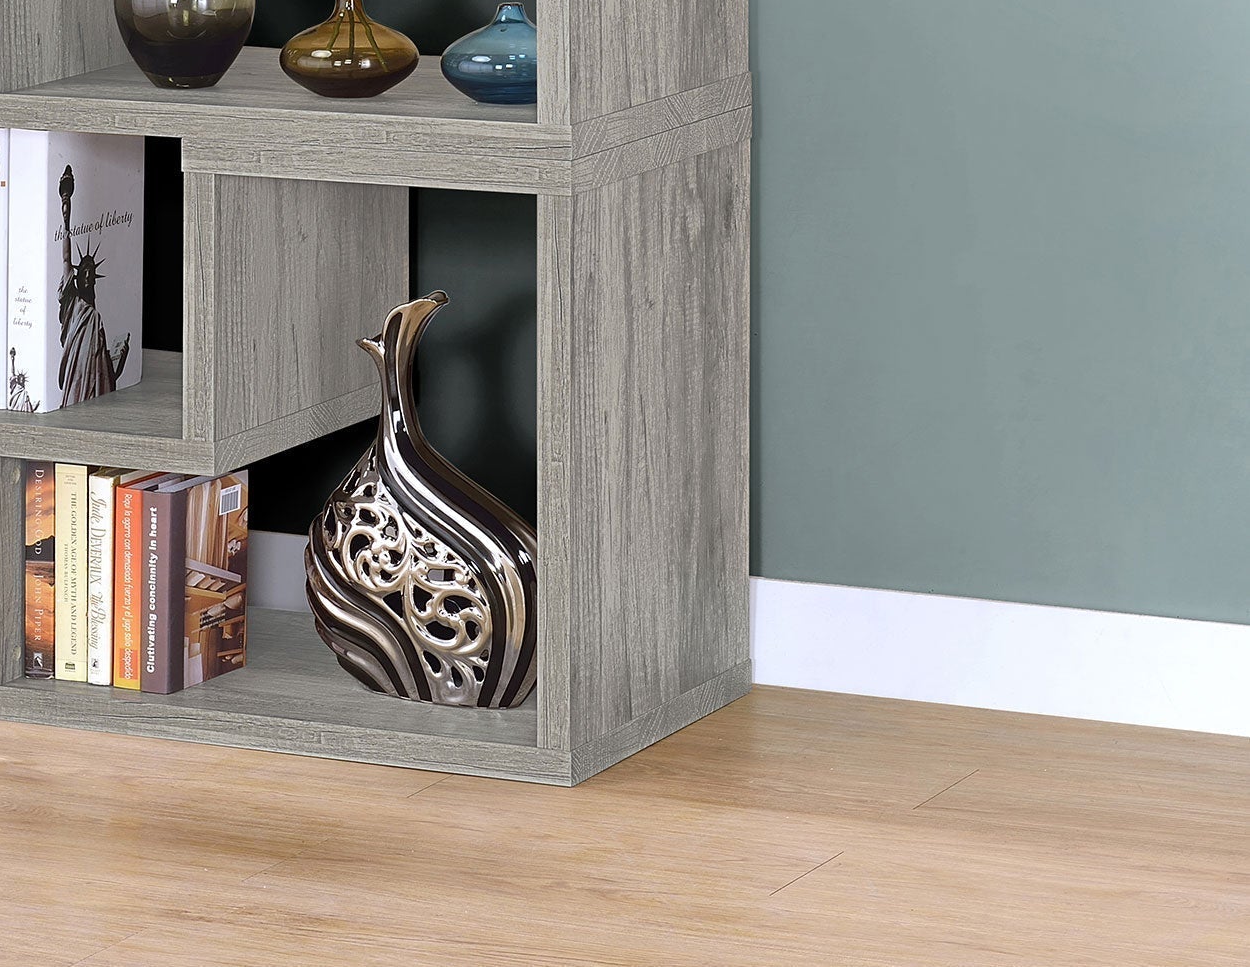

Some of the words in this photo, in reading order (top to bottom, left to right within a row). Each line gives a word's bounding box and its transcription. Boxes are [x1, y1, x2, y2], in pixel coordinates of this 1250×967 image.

[54, 225, 68, 242] the
[67, 222, 95, 239] statue
[94, 213, 105, 236] of
[105, 210, 134, 228] liberty
[13, 317, 33, 329] liberty
[19, 306, 27, 316] of
[34, 469, 44, 525] DESIRING
[90, 492, 106, 525] Jude
[34, 529, 43, 555] GOD
[89, 527, 106, 586] DEVERAUX
[148, 539, 157, 551] in
[70, 564, 77, 575] OF
[147, 553, 158, 611] concinnity
[34, 574, 42, 605] JOHN
[124, 584, 133, 605] fuerza
[34, 608, 43, 642] PIPER
[88, 608, 106, 650] Blessing
